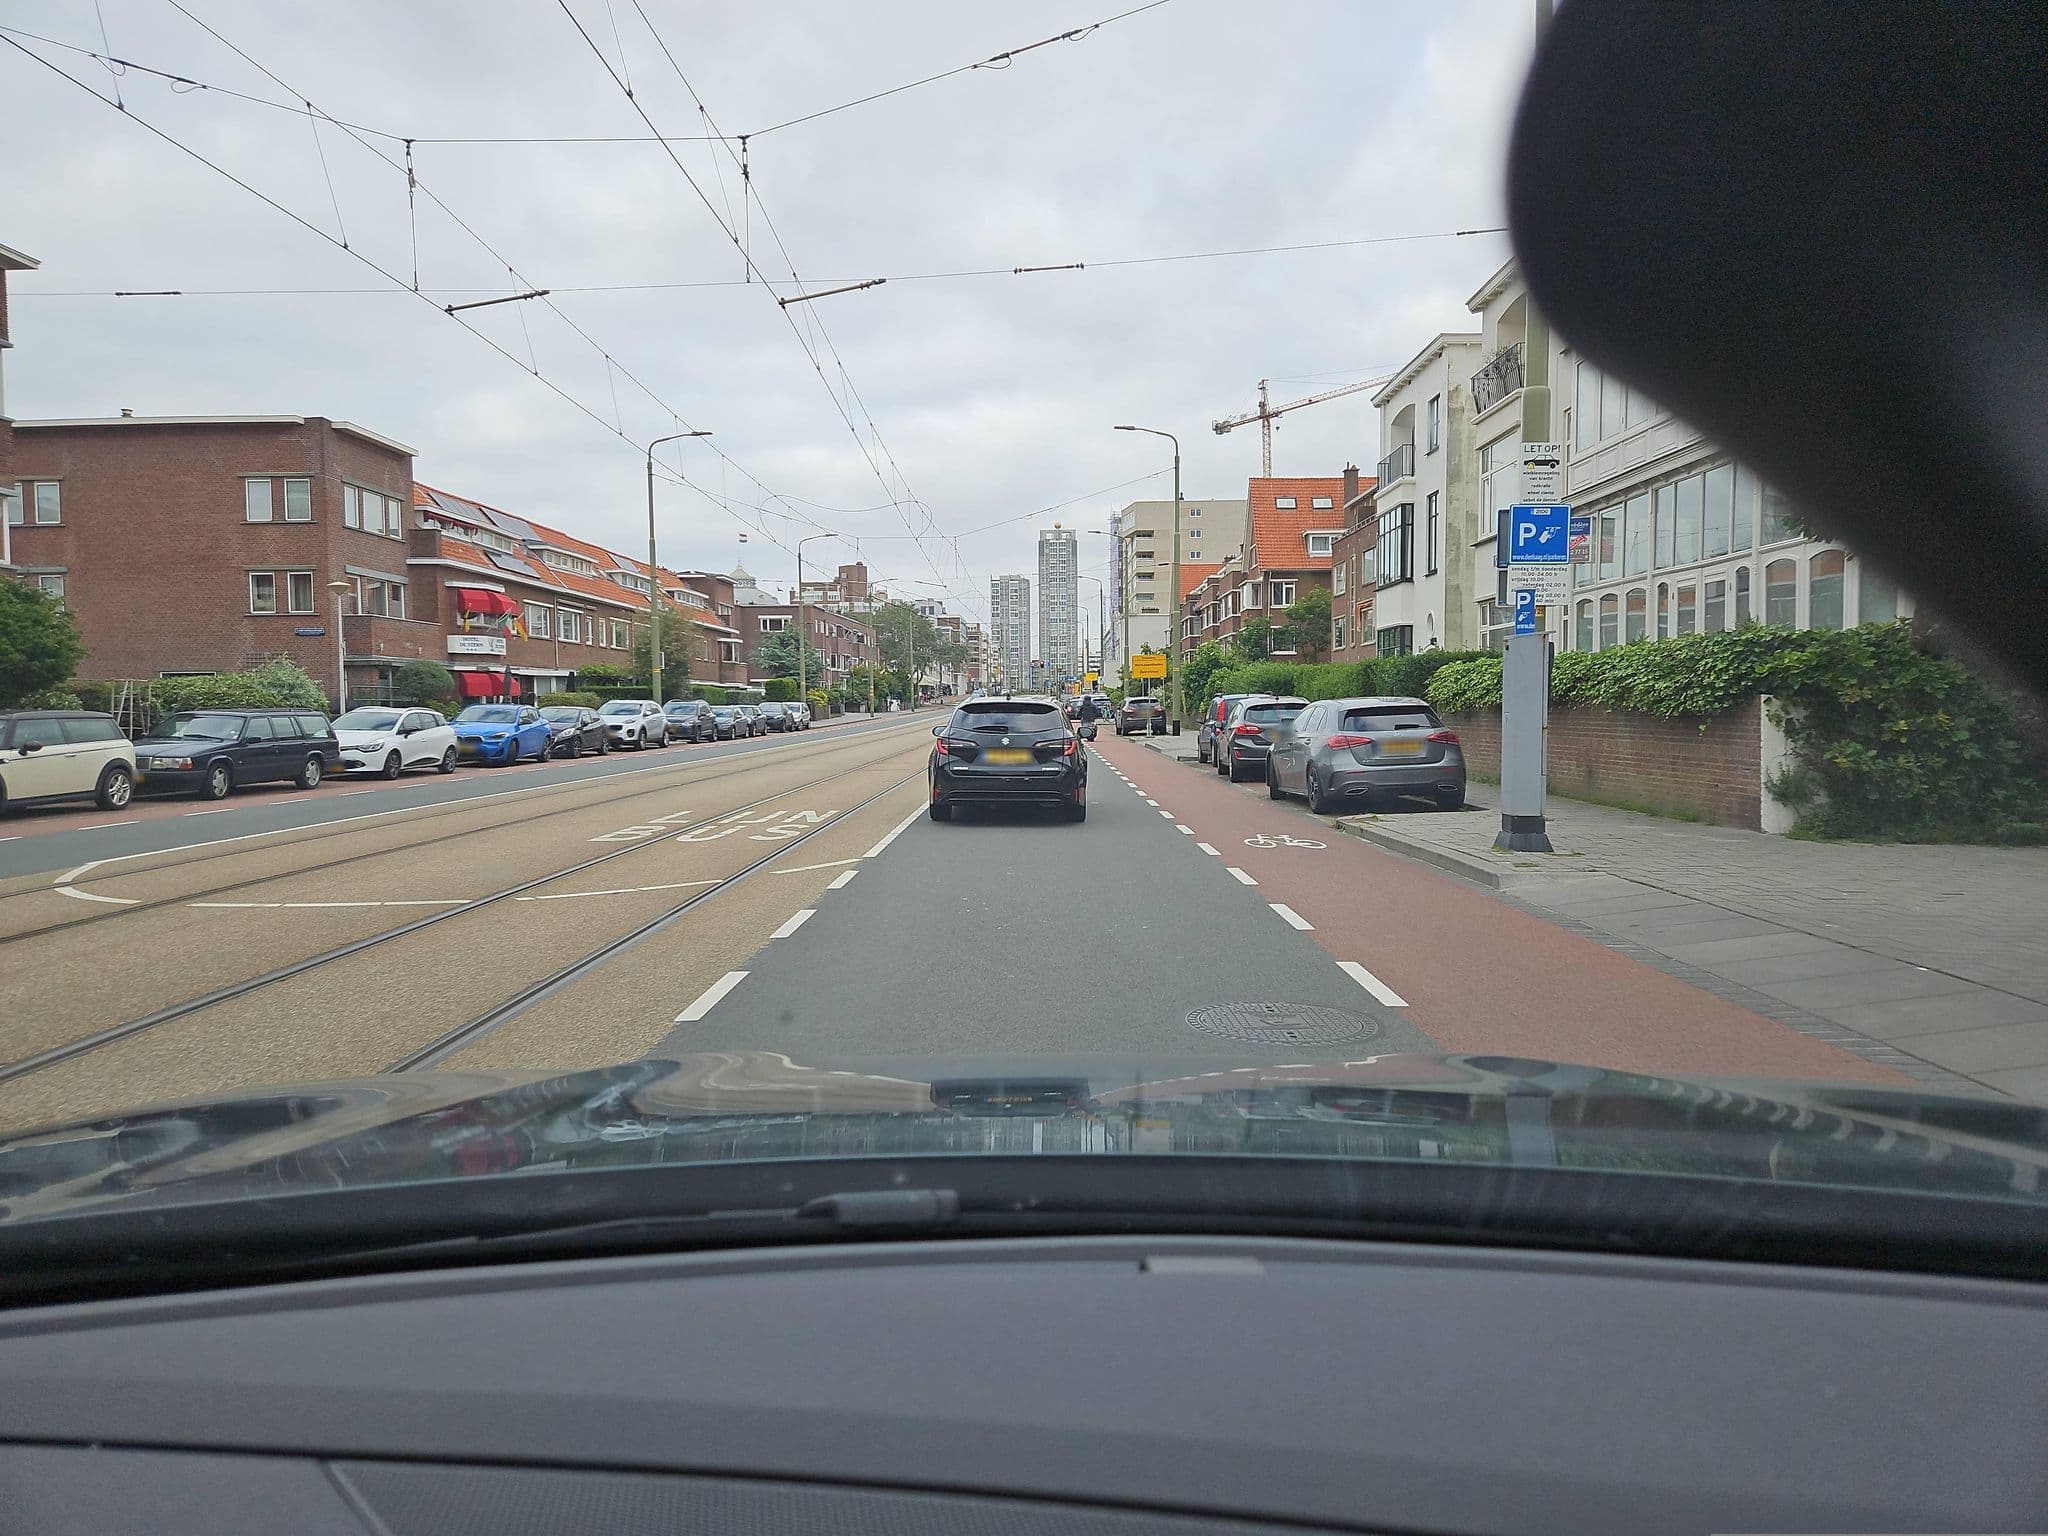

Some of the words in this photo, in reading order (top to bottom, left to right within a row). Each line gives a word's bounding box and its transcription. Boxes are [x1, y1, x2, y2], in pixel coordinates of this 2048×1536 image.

[1524, 444, 1542, 453] LET
[1544, 444, 1561, 453] OP!
[1519, 522, 1537, 547] P
[1517, 592, 1531, 610] P
